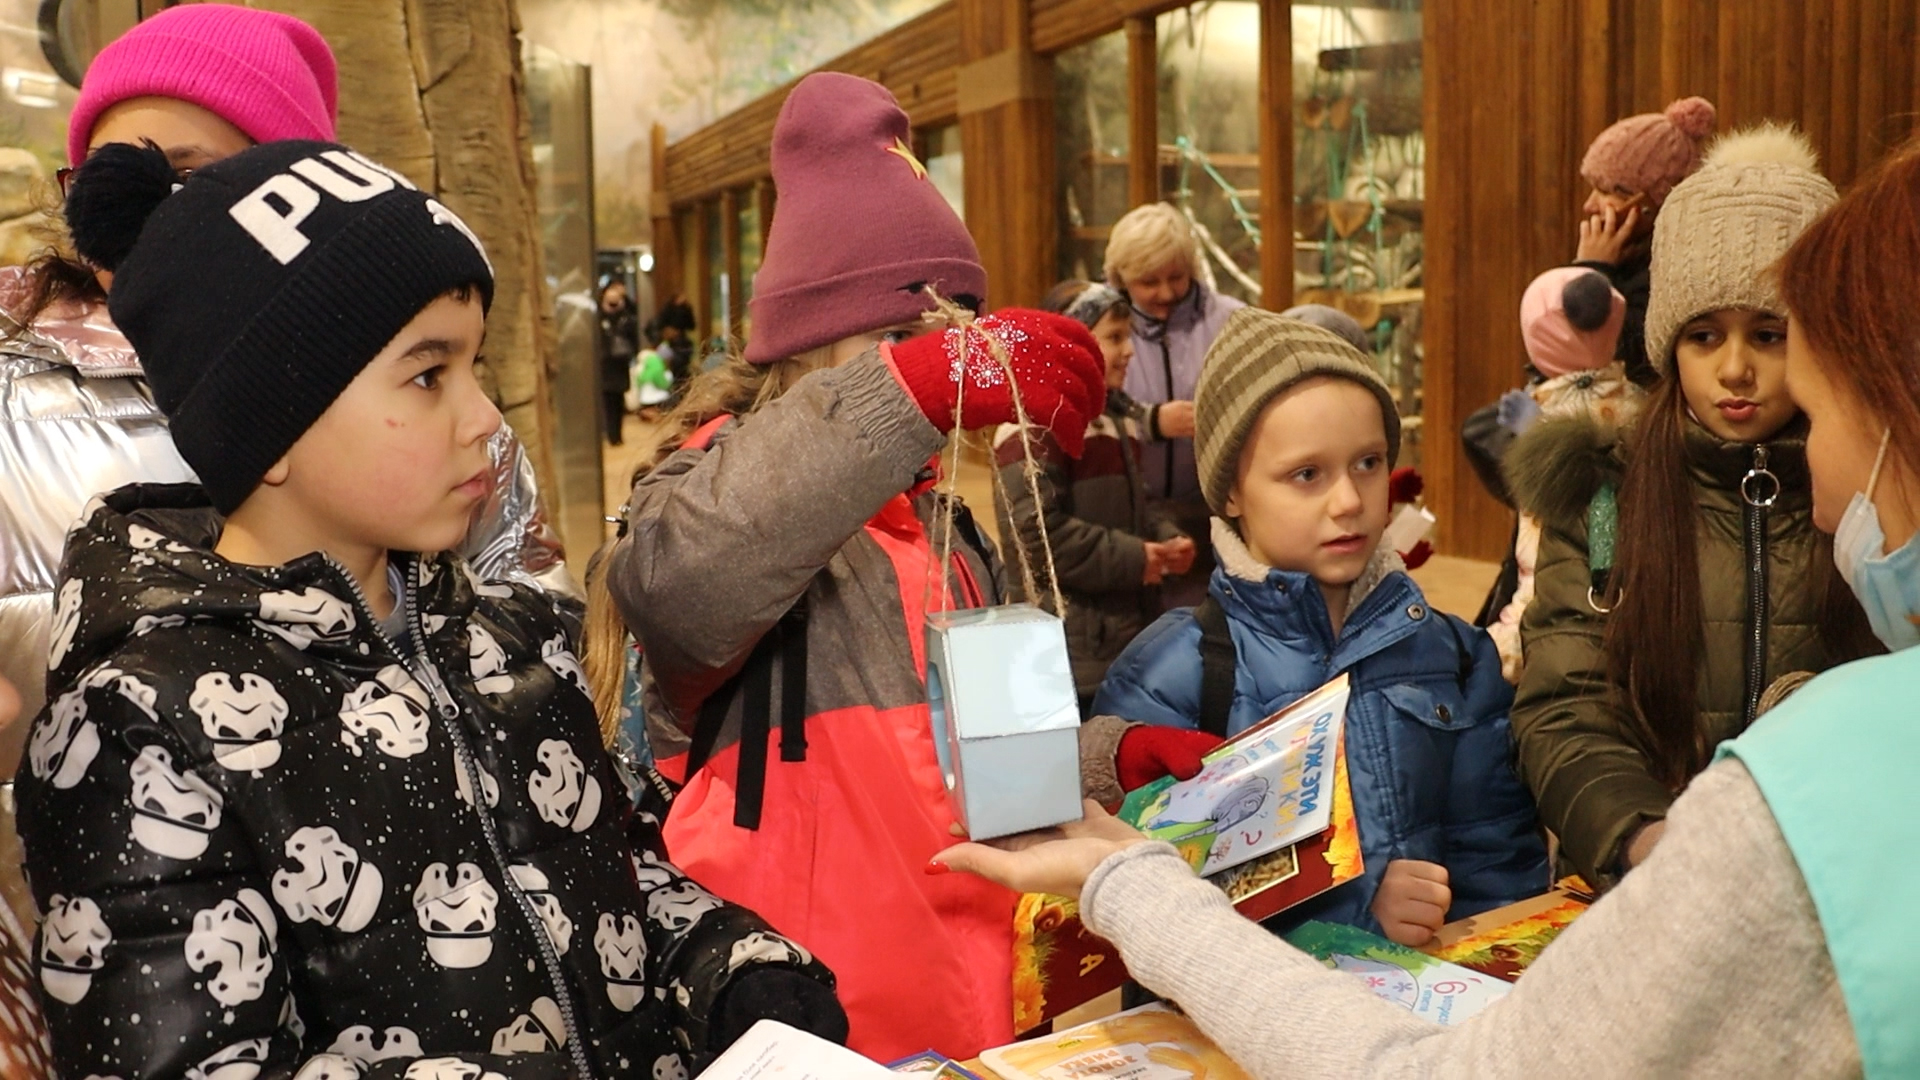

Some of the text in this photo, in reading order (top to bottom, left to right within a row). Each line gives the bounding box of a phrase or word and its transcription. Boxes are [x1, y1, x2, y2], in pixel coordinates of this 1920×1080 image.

[228, 150, 417, 266] PU
[1298, 711, 1333, 816] ОХ УЖ ЭТИ
